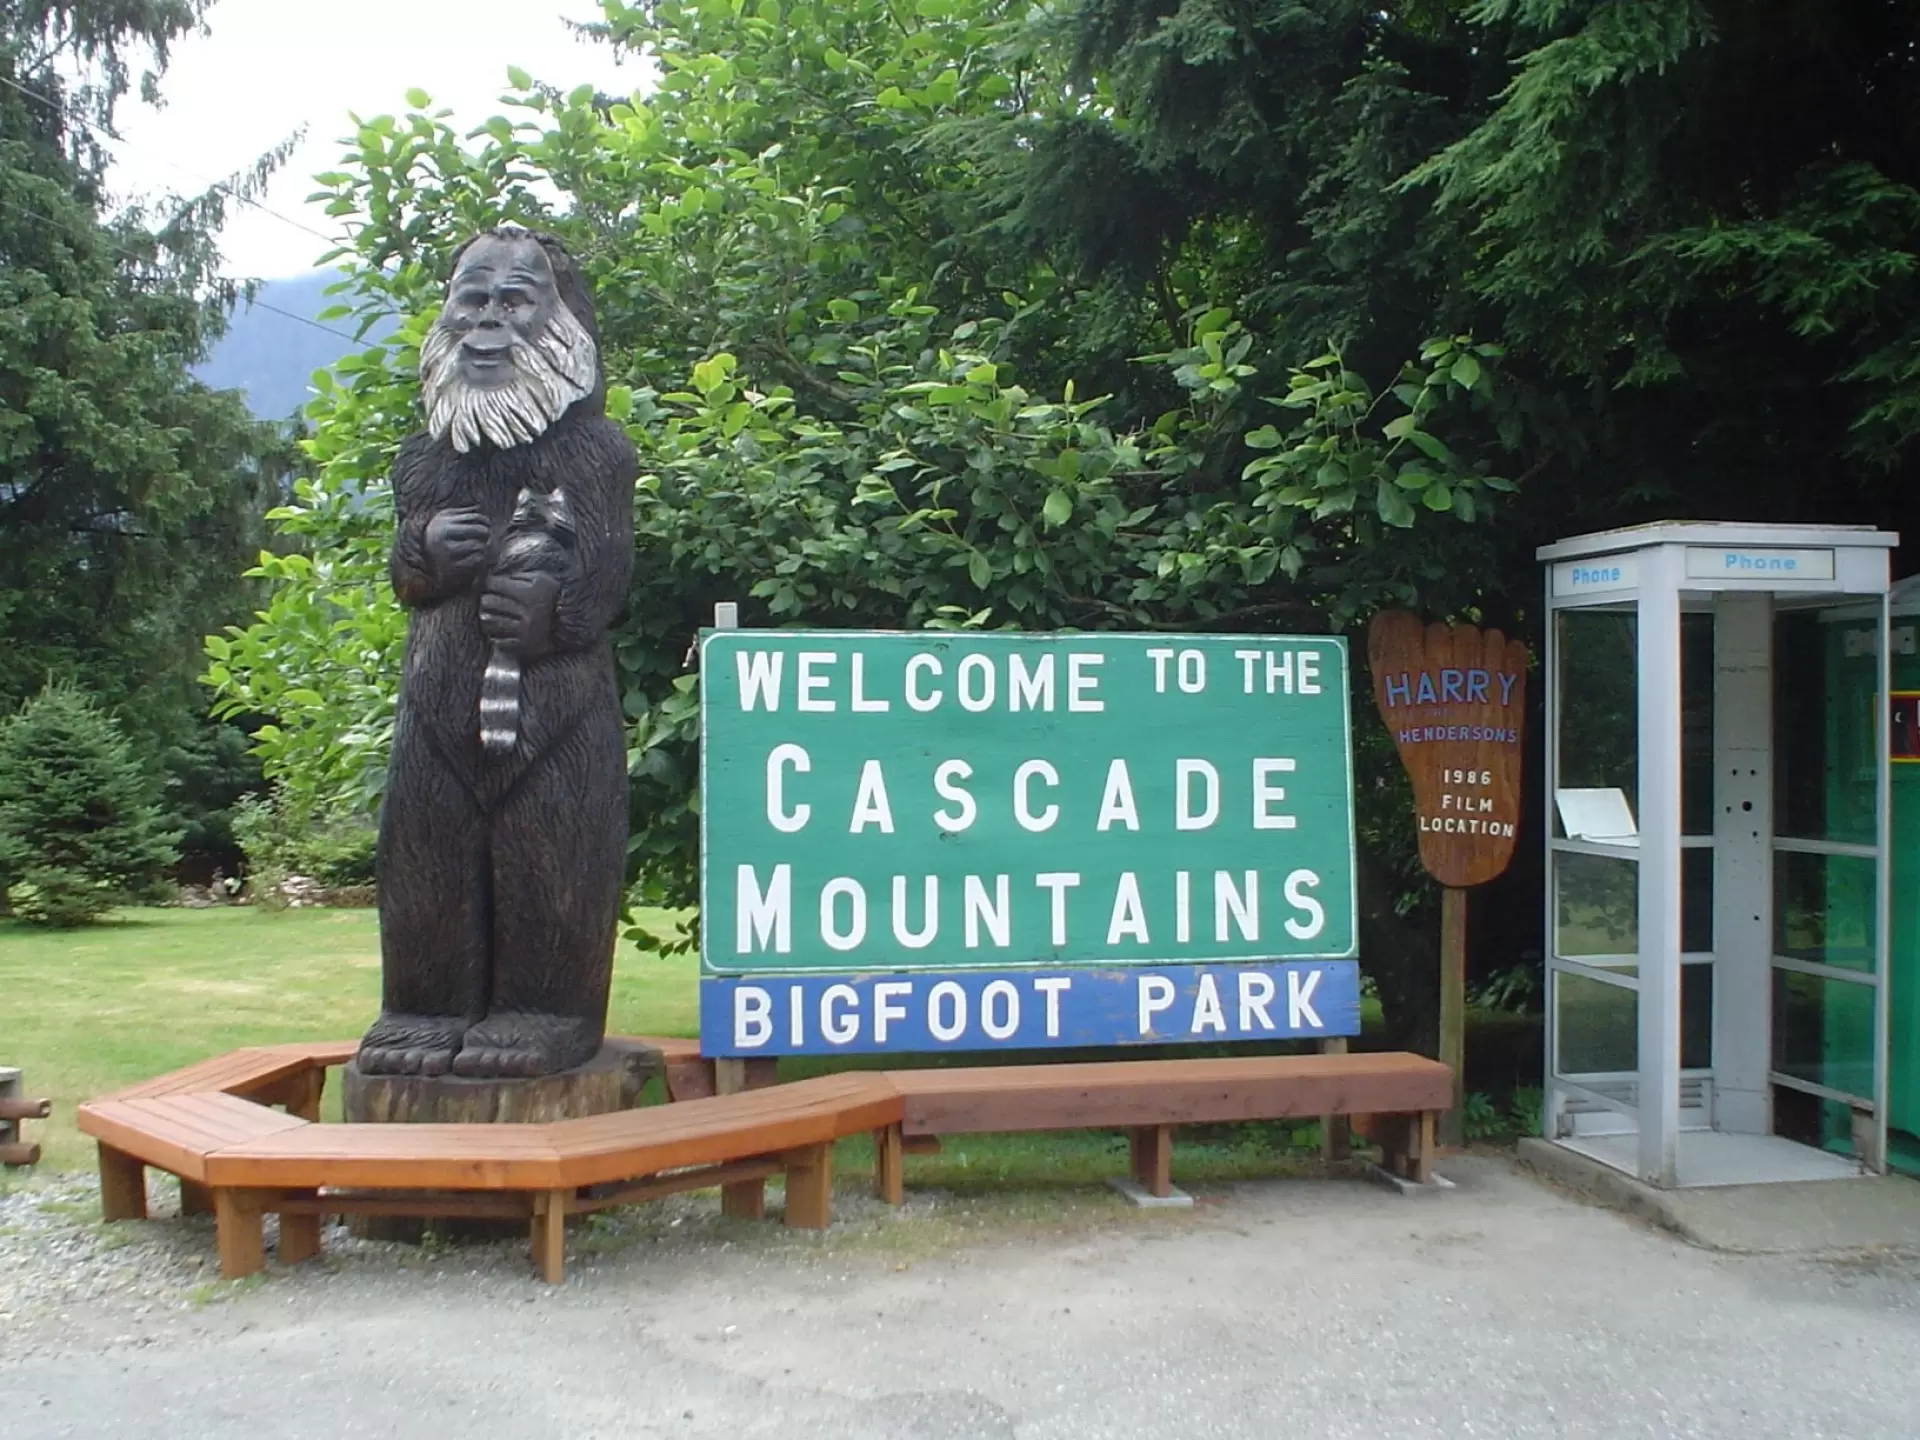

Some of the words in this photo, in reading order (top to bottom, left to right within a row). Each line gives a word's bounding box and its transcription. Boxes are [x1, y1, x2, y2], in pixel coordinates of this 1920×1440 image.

[1725, 554, 1797, 570] Phone
[1572, 566, 1620, 585] Phone
[736, 651, 1105, 713] WELCOME
[1146, 648, 1206, 693] TO
[1235, 650, 1321, 694] THE
[1385, 669, 1517, 707] HARRY
[1400, 726, 1517, 744] HENDERSONS
[1443, 769, 1492, 785] 1986
[766, 743, 1297, 834] CASCADE
[1441, 795, 1493, 812] FILM
[1420, 816, 1514, 838] LOCATION
[736, 863, 1325, 954] MOUNTAINS
[733, 976, 1071, 1048] BIGFOOT
[1137, 970, 1323, 1035] PARK
